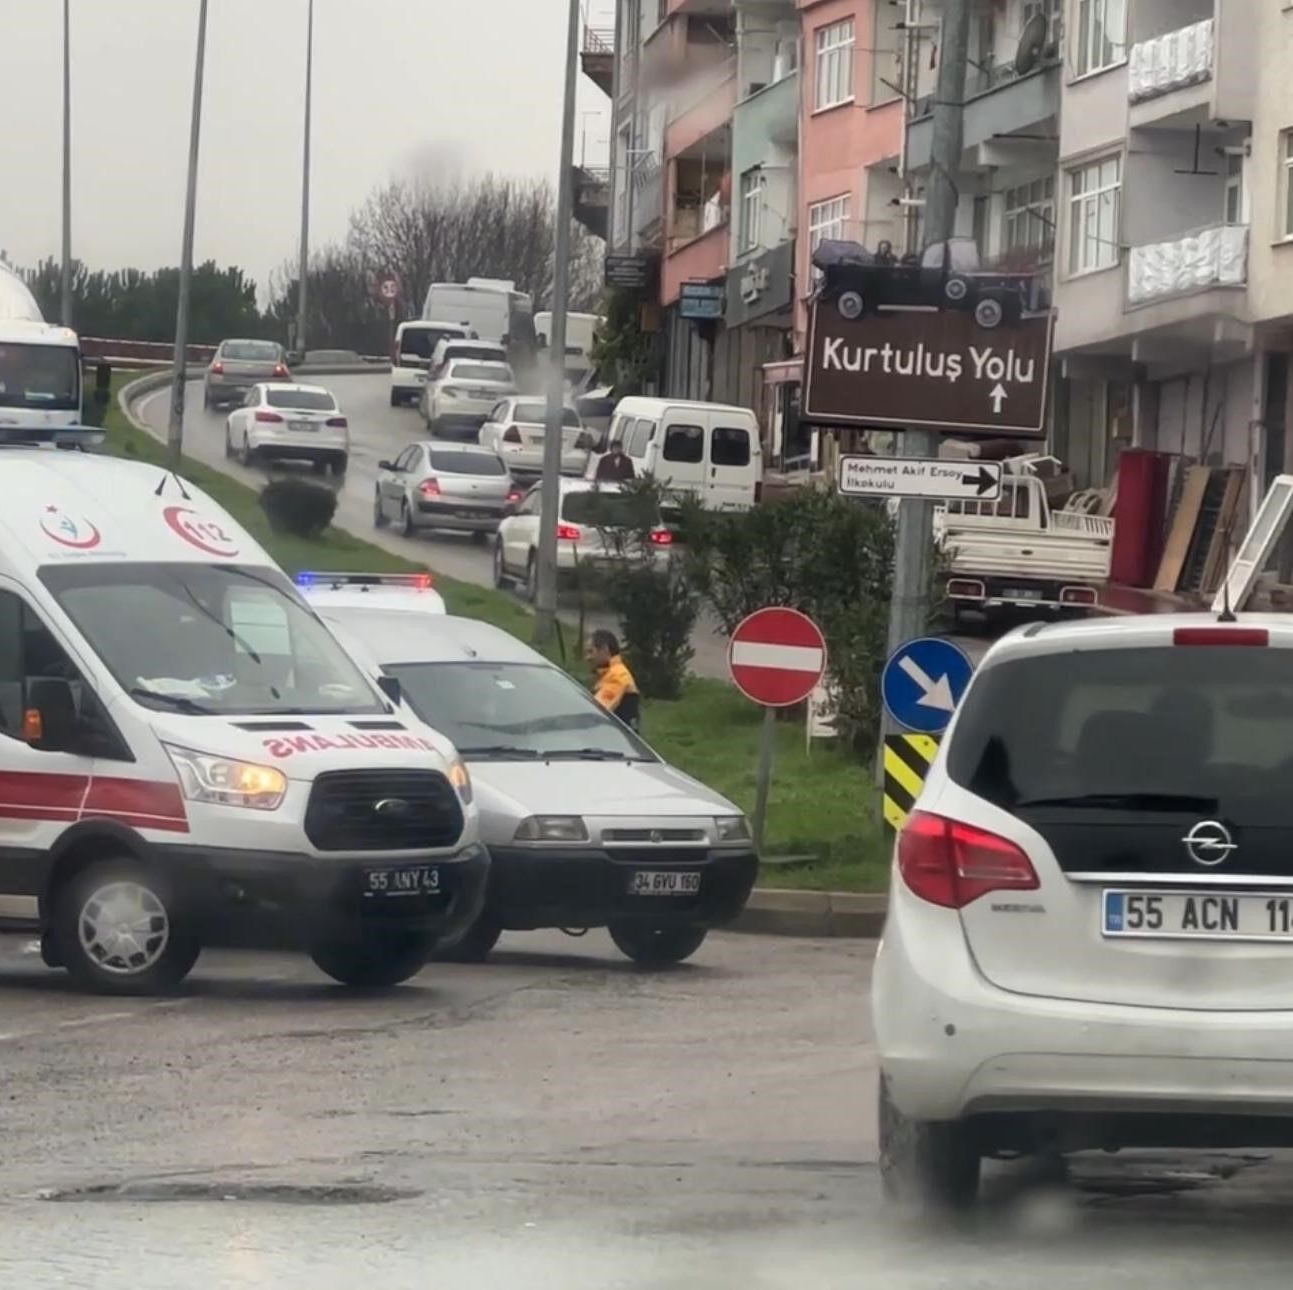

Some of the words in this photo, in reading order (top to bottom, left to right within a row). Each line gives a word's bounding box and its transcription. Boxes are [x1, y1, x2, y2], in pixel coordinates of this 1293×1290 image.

[822, 337, 962, 382] Kurtuluş
[969, 346, 1034, 382] Yolu
[848, 463, 898, 475] Mehmet
[902, 466, 925, 476] Akif
[930, 466, 963, 481] Ersoy
[184, 521, 232, 542] 112
[369, 872, 388, 890] 55
[422, 869, 439, 887] 43
[636, 873, 650, 889] 34
[1127, 896, 1163, 929] 55
[1181, 897, 1239, 931] ACN
[1266, 900, 1293, 932] 11
